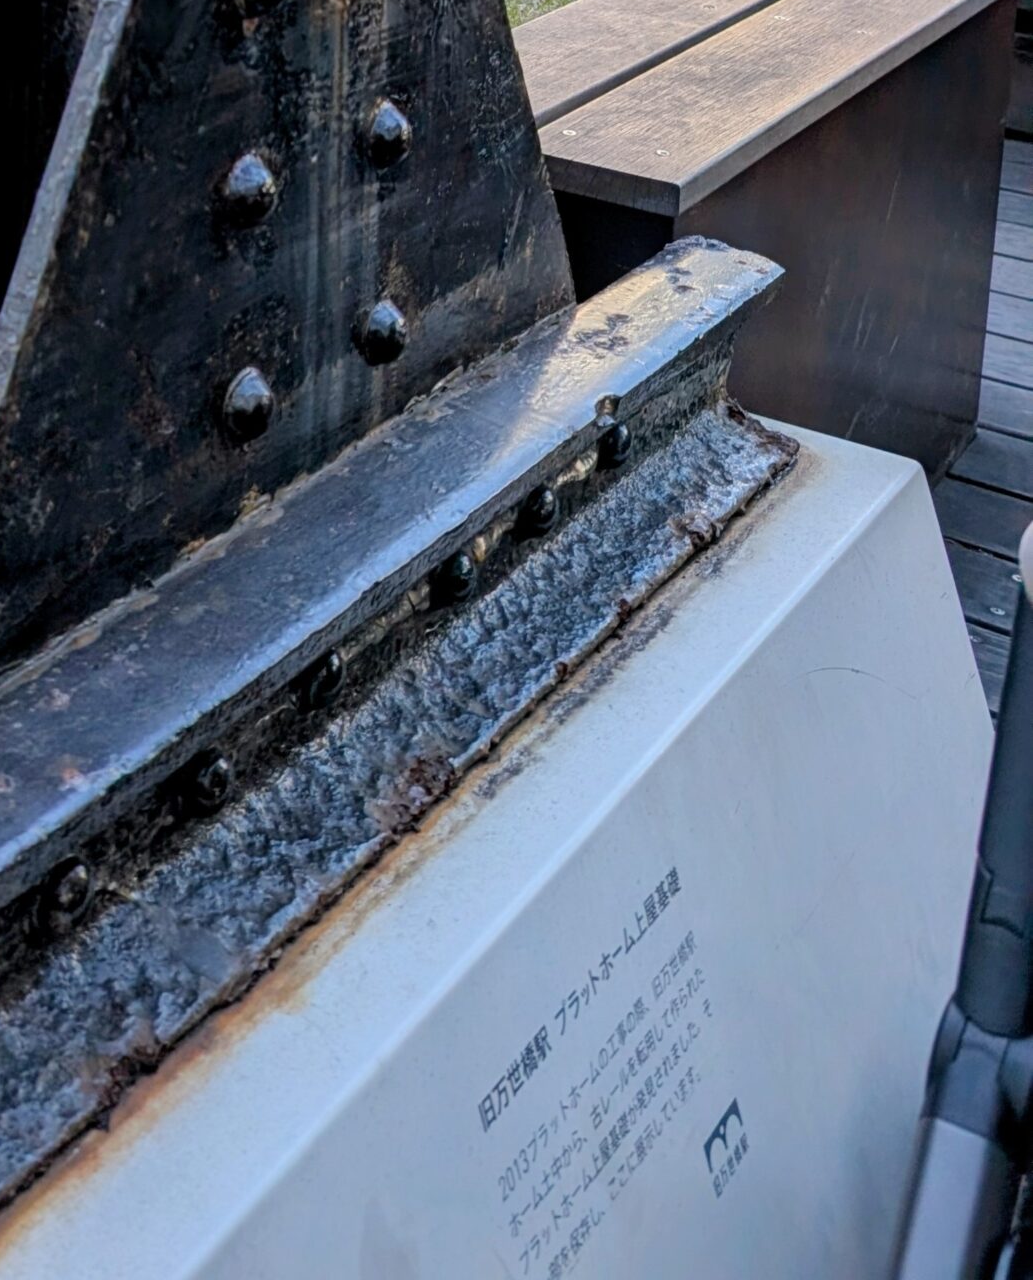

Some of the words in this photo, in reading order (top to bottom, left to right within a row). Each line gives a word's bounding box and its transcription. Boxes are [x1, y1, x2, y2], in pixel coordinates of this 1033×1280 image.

[477, 1024, 554, 1133] 旧万世橋駅
[553, 865, 684, 1037] プラットホーム上屋基礎
